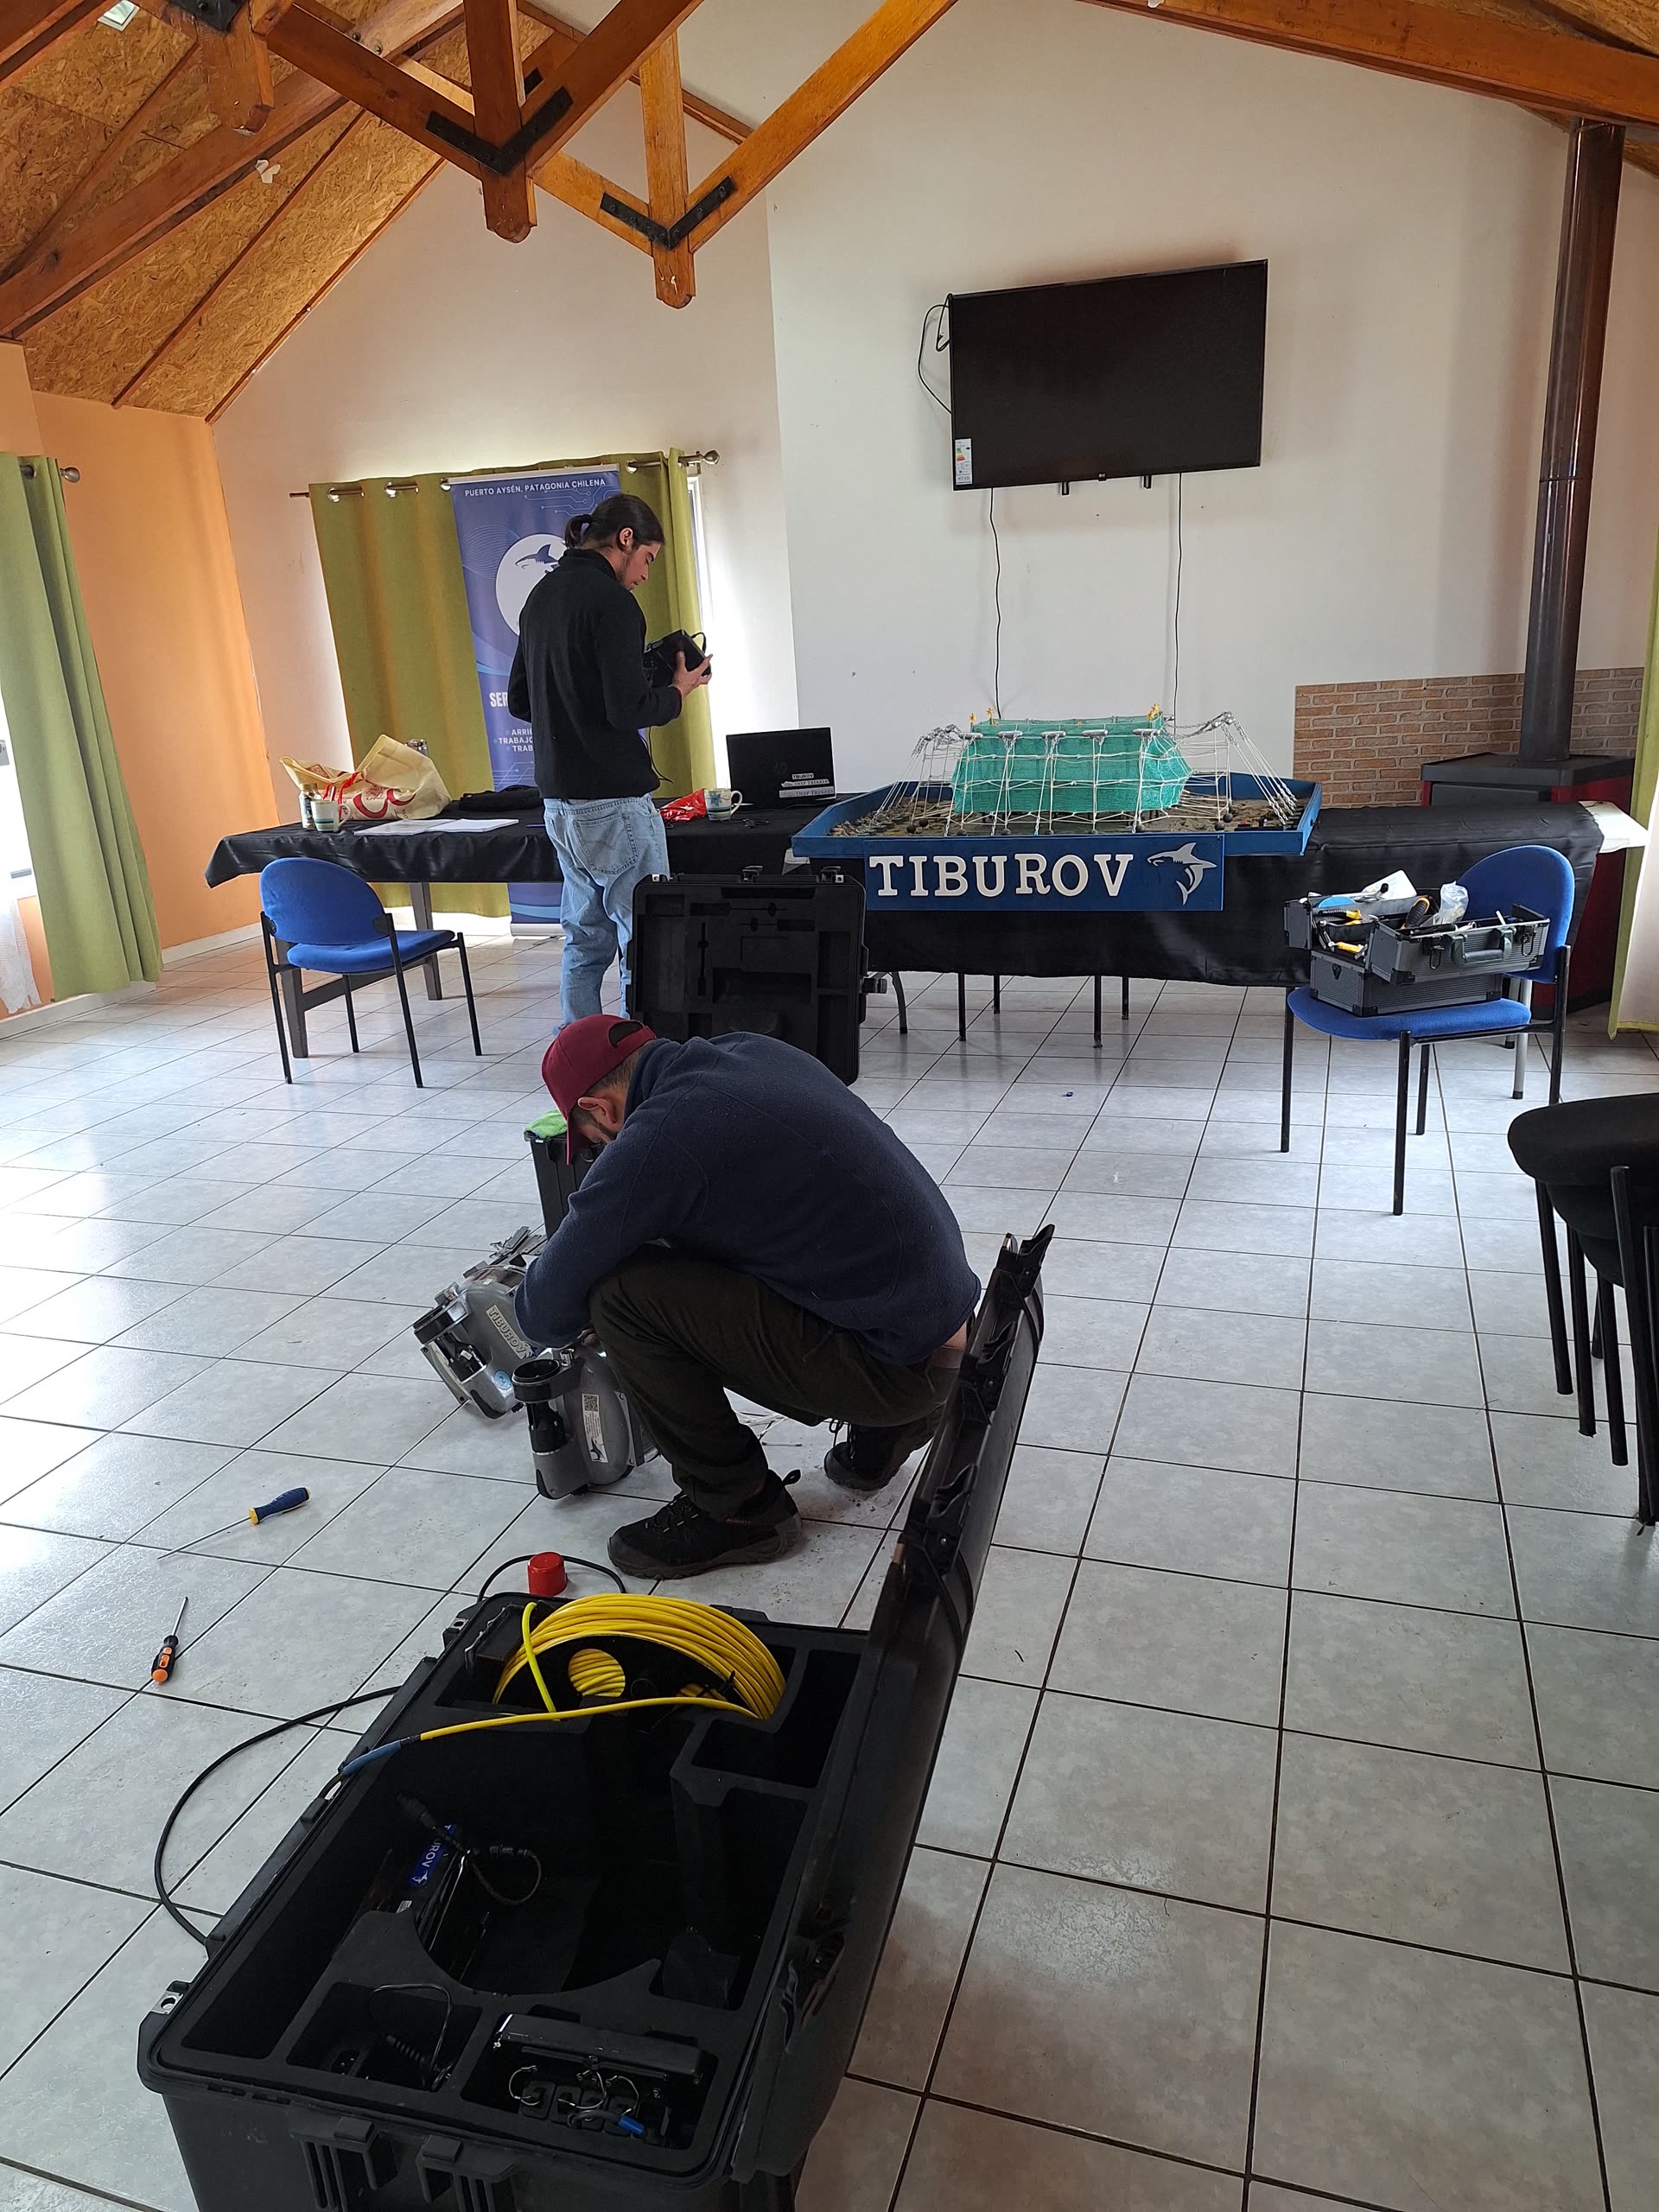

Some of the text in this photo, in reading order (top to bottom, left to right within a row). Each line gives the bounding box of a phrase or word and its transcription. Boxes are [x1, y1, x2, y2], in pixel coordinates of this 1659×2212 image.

[465, 479, 606, 497] PUERTO AYSÉN, PATAGONIA CHILENA
[869, 853, 1134, 898] TIBUROV
[489, 1307, 527, 1353] TIBUROV
